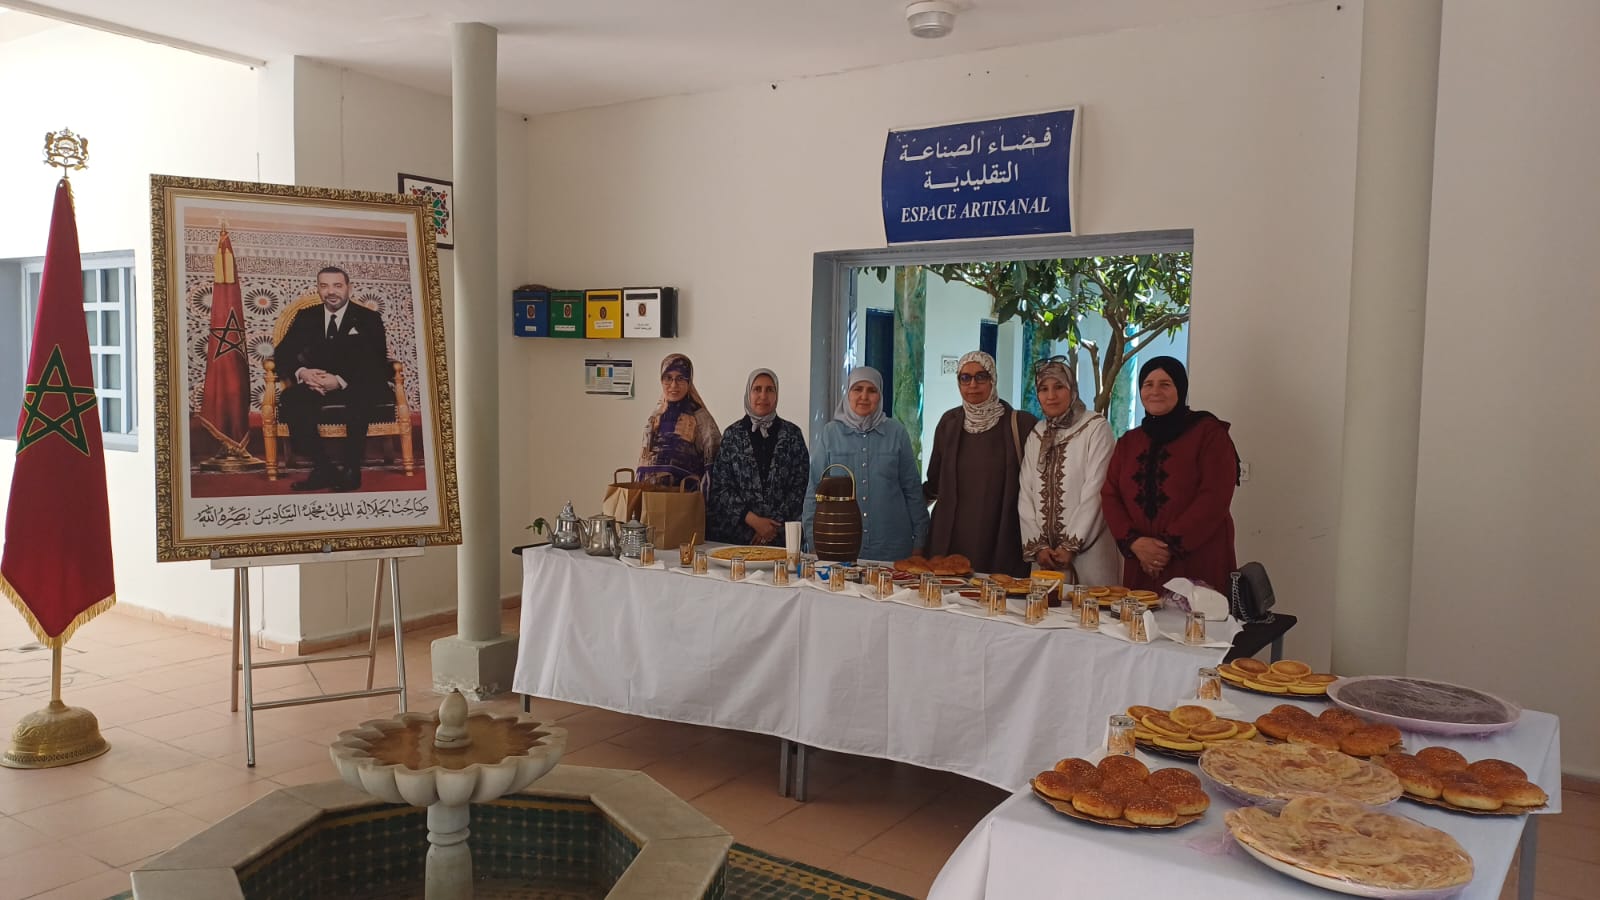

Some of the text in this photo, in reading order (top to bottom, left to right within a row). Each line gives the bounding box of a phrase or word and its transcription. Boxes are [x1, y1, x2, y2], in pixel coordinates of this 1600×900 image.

[899, 126, 1052, 162] فضاء الصناعة
[923, 160, 1020, 193] التقليدية
[901, 196, 1050, 223] ESPACE ARTISANAL
